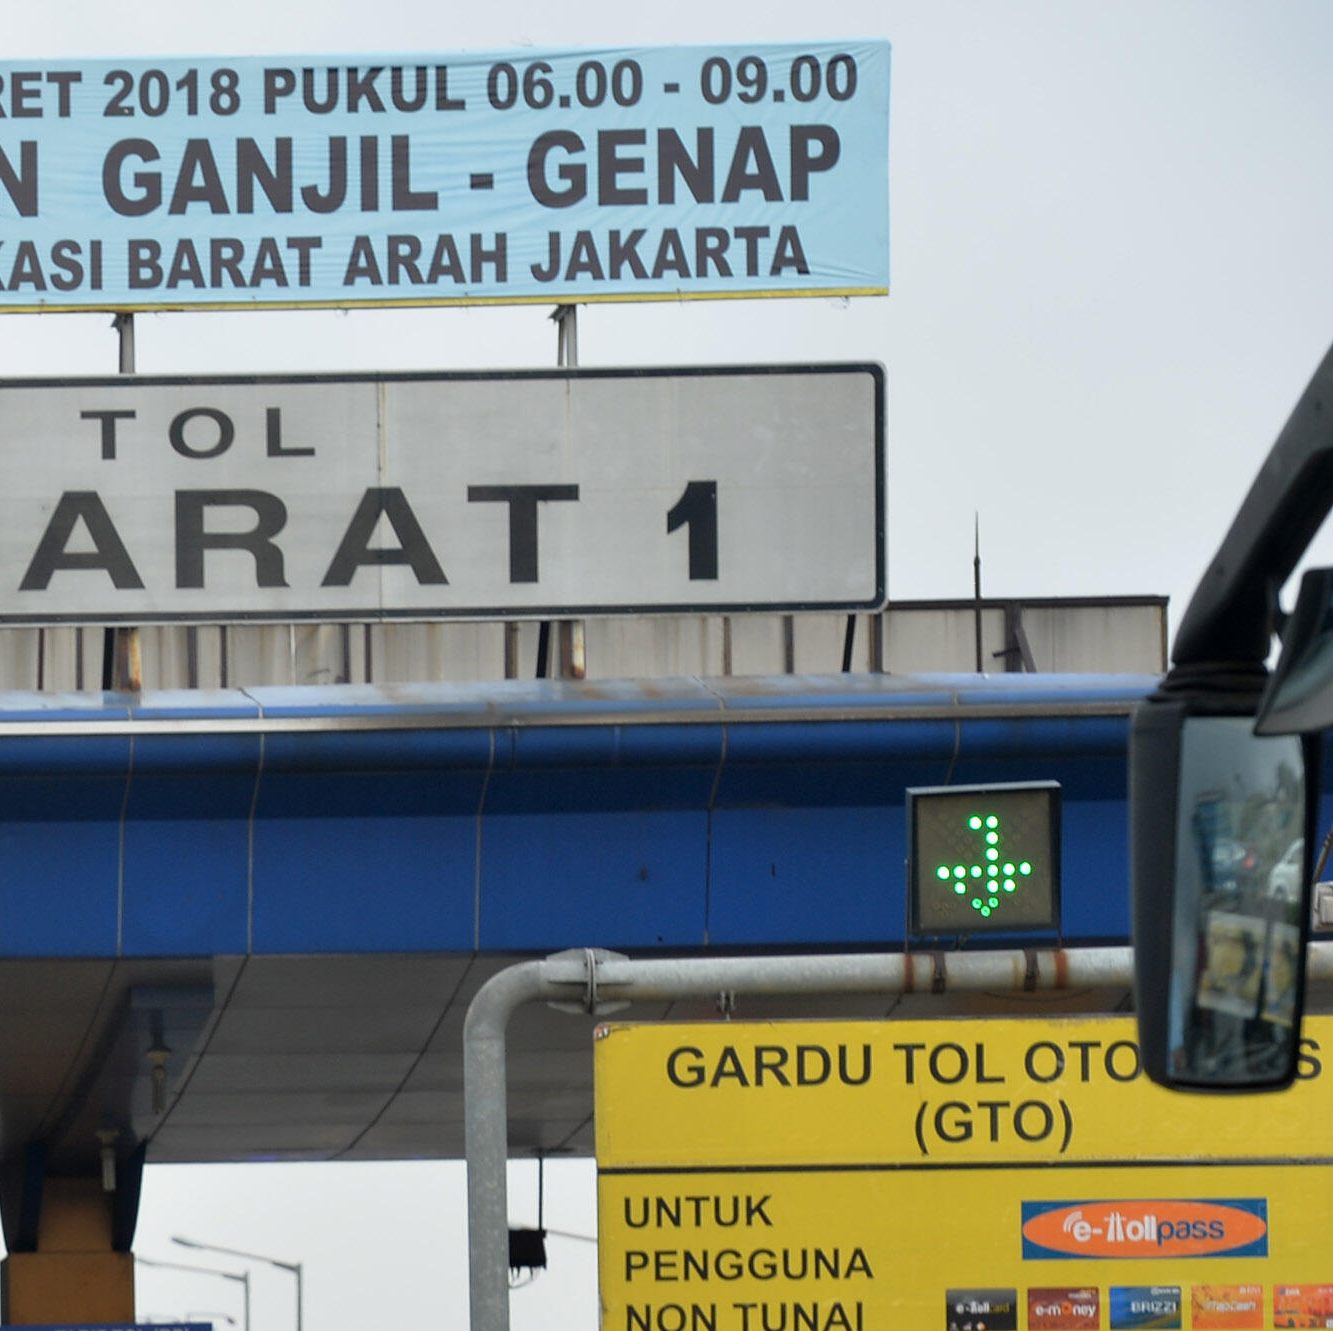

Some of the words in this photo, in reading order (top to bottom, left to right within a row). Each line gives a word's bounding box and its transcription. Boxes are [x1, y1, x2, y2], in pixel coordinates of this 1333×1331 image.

[102, 68, 240, 117] 2018
[264, 65, 466, 114] PUKUL
[485, 58, 643, 110] 06.00
[662, 82, 681, 91] -
[699, 53, 858, 103] 09.00
[101, 133, 439, 216] GANJIL
[467, 171, 495, 190] -
[526, 123, 841, 208] GENAP
[128, 233, 324, 289] BARAT
[342, 231, 507, 286] ARAH
[530, 224, 810, 283] JAKARTA
[80, 407, 315, 461] TOL
[666, 480, 720, 582] 1
[666, 1043, 873, 1088] GARDU
[893, 1041, 1005, 1085] TOL
[914, 1099, 1073, 1155] (GTO)
[624, 1195, 773, 1229] UNTUK
[624, 1248, 874, 1282] PENGGUNA
